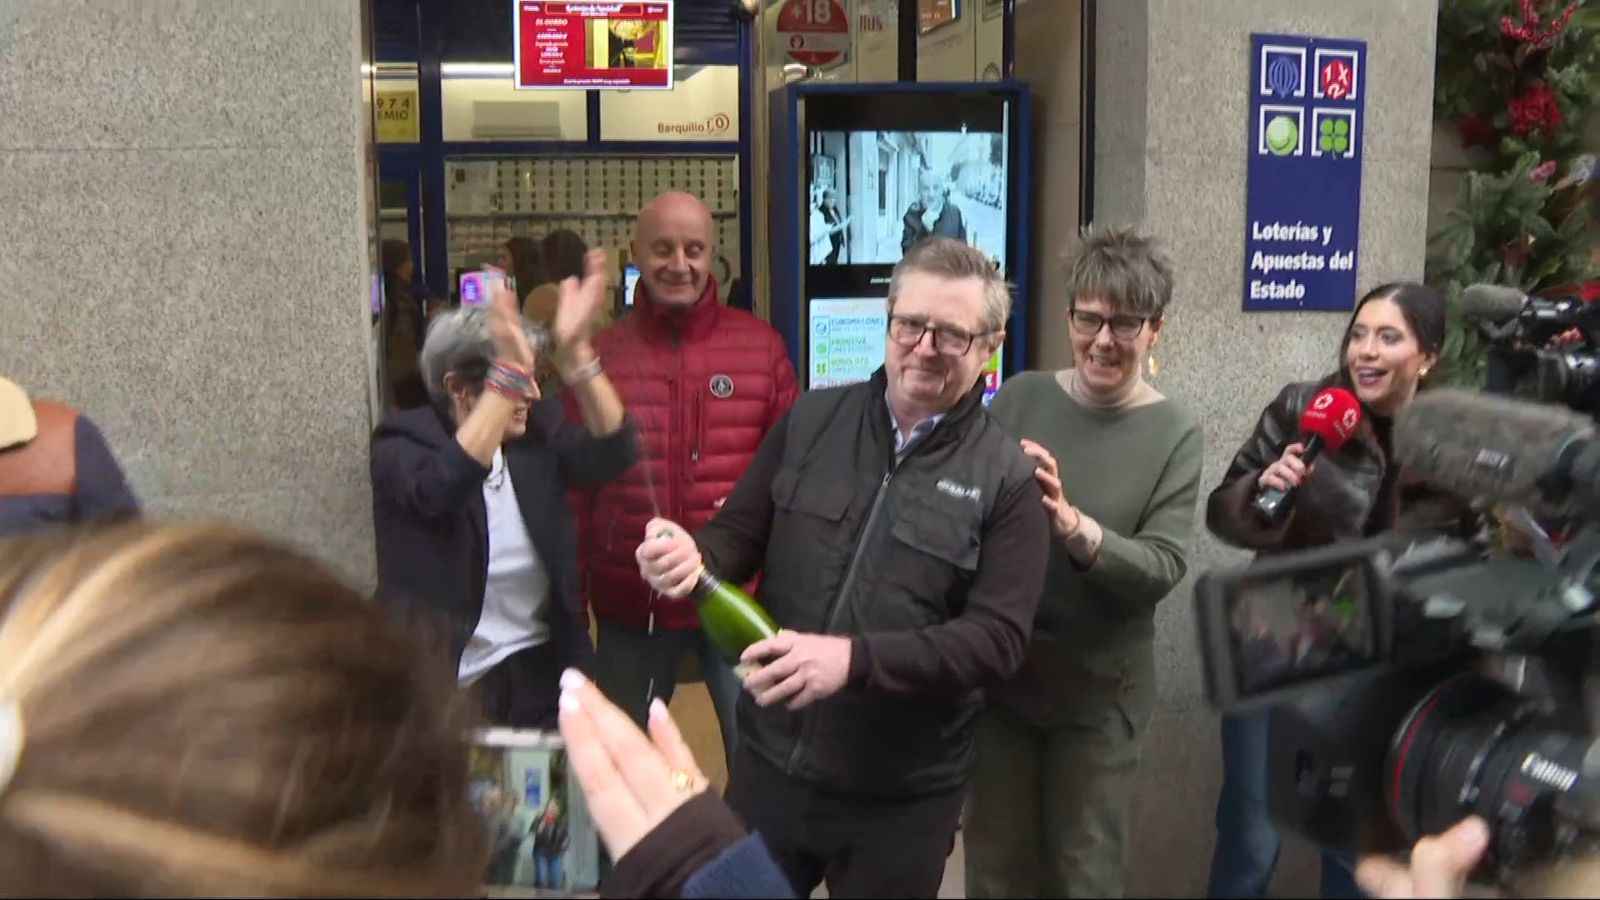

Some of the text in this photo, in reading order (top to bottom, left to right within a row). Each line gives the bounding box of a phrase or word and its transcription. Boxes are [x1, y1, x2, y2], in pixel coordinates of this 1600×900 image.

[657, 121, 705, 135] Barquillo
[1252, 220, 1333, 247] Loterías y
[1250, 250, 1354, 275] Apuestas del
[1250, 279, 1306, 300] Estado
